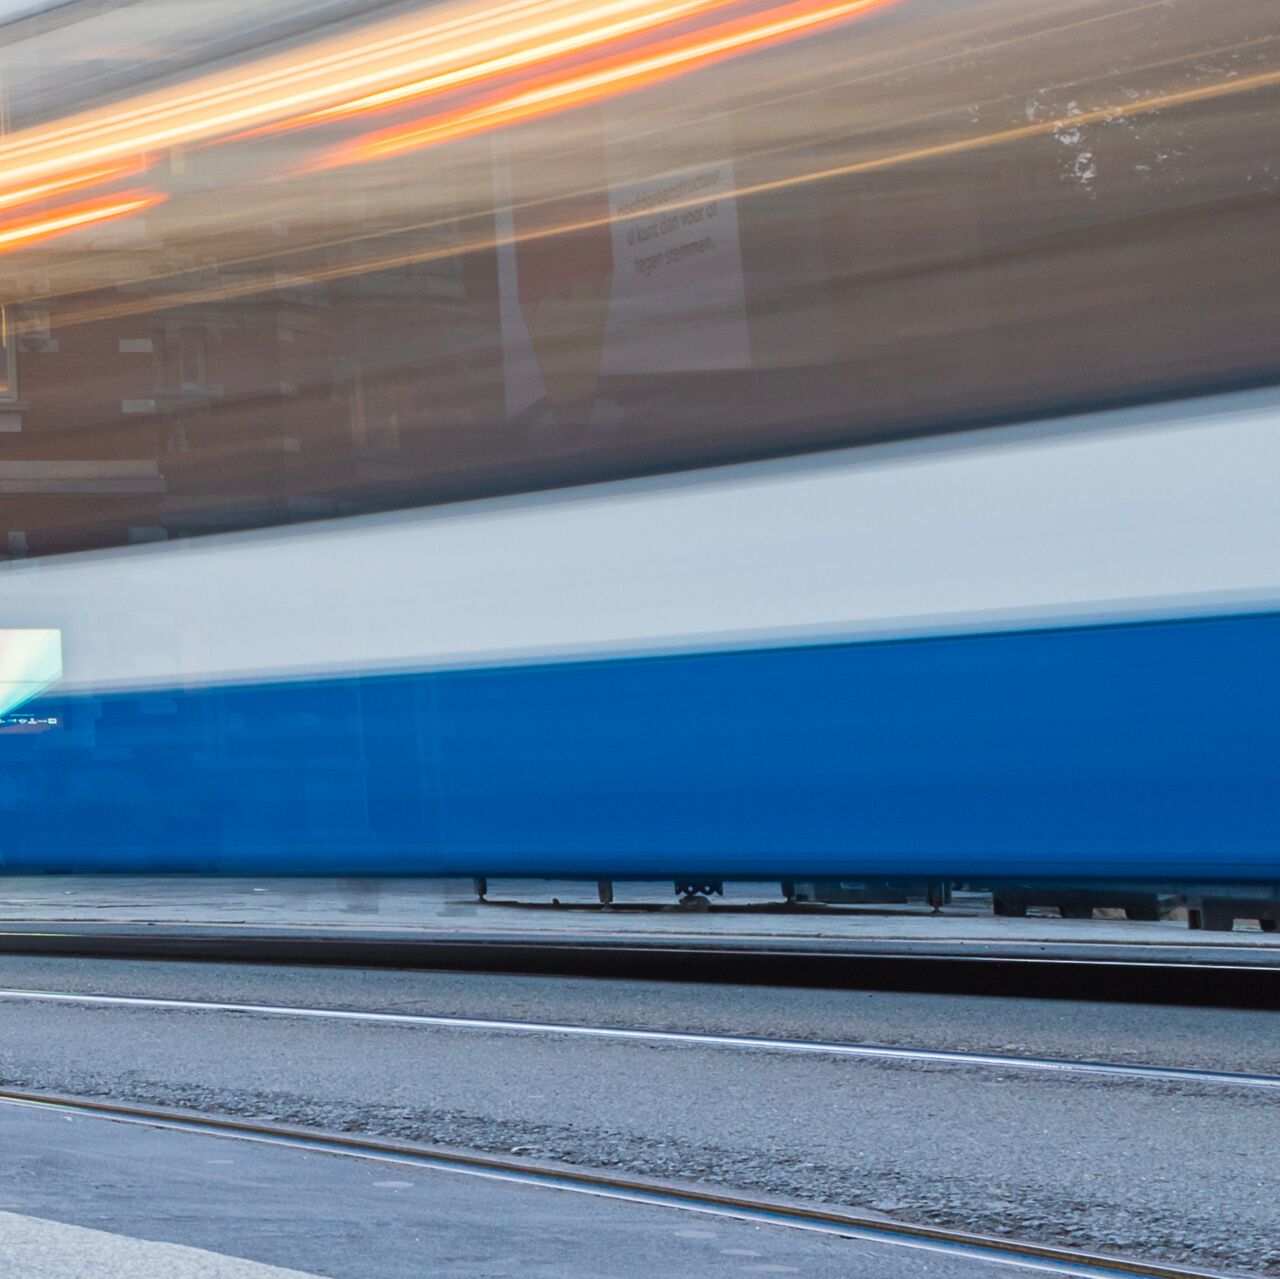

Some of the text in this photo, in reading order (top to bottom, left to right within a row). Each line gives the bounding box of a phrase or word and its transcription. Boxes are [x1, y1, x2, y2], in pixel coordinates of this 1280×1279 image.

[636, 225, 659, 242] kunt
[660, 214, 679, 236] dan
[681, 207, 704, 227] voor
[706, 201, 718, 219] of
[634, 253, 663, 276] tegen
